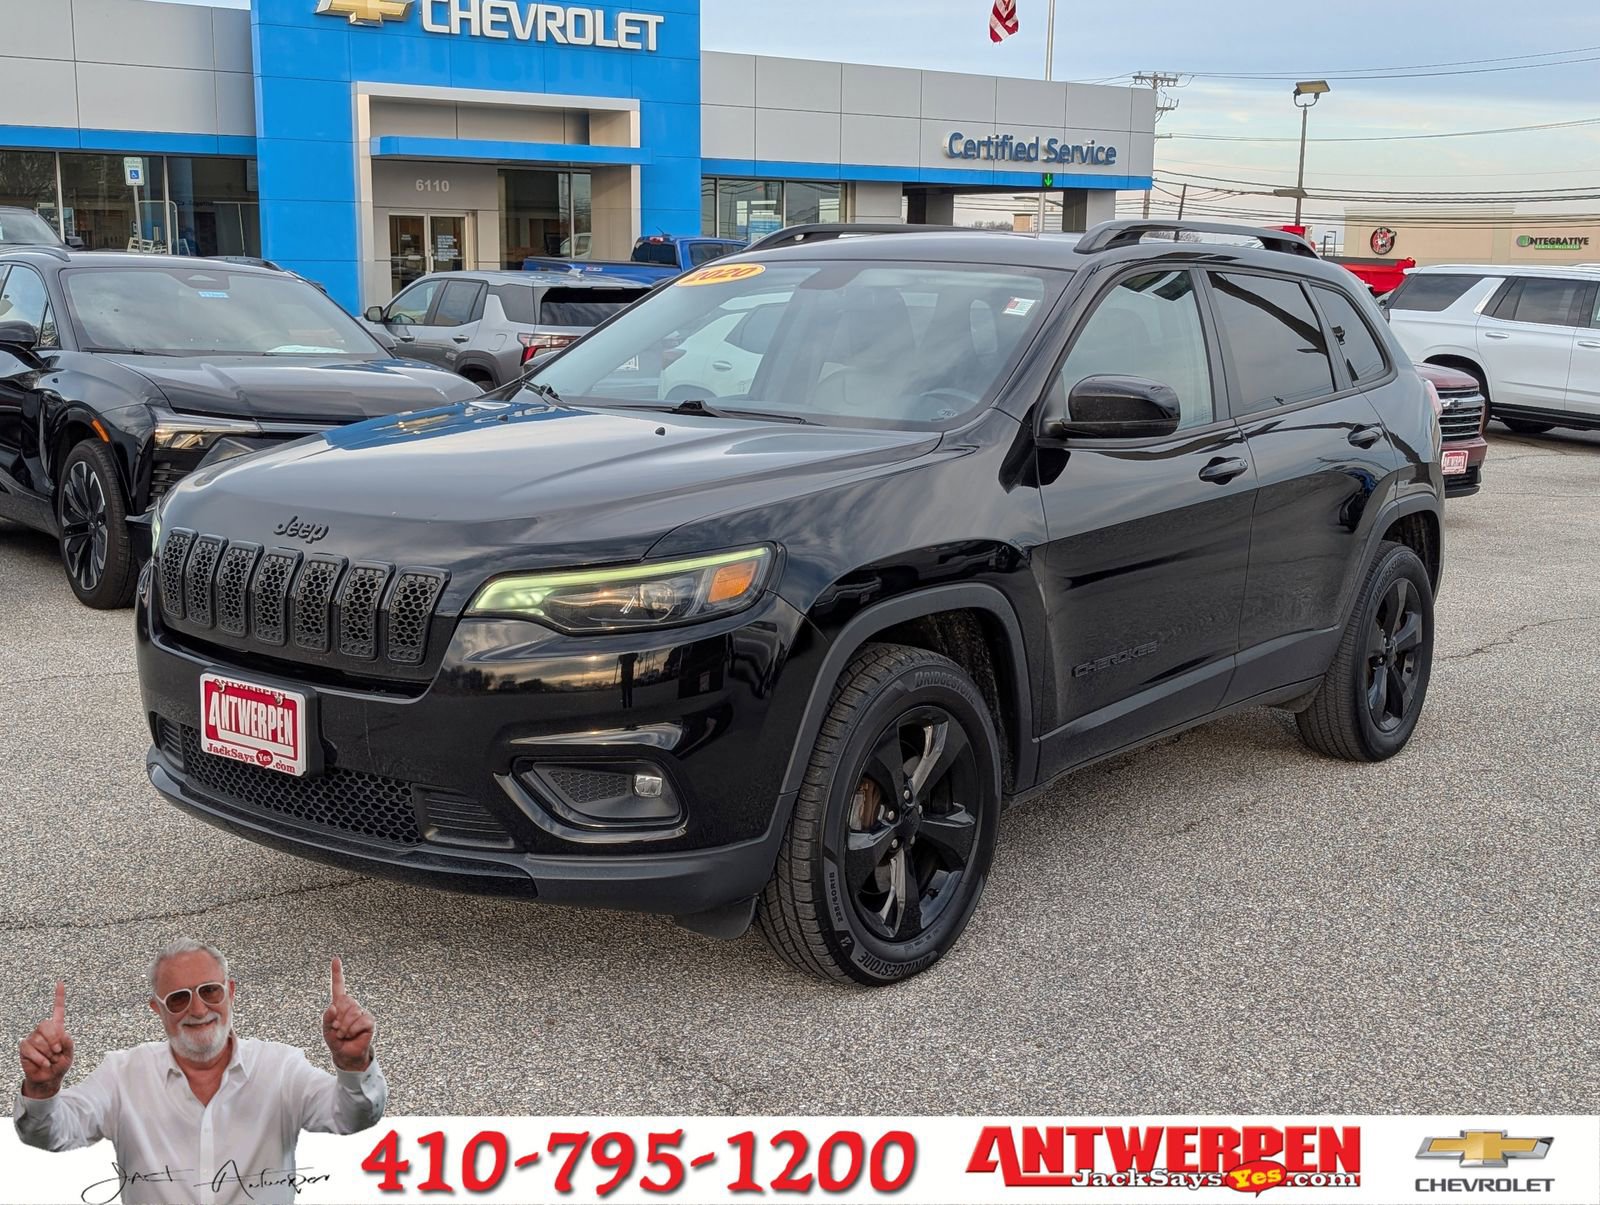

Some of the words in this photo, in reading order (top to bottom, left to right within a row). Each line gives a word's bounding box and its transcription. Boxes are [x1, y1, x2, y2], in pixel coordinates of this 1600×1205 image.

[420, 0, 665, 50] CHEVROLET
[946, 131, 1039, 162] Certified
[1042, 138, 1117, 165] Service
[415, 179, 450, 193] 6110
[681, 267, 758, 283] 2020
[273, 516, 329, 544] Jeep
[1071, 640, 1161, 678] CHEROKEE
[208, 691, 294, 746] ANTWERPEN
